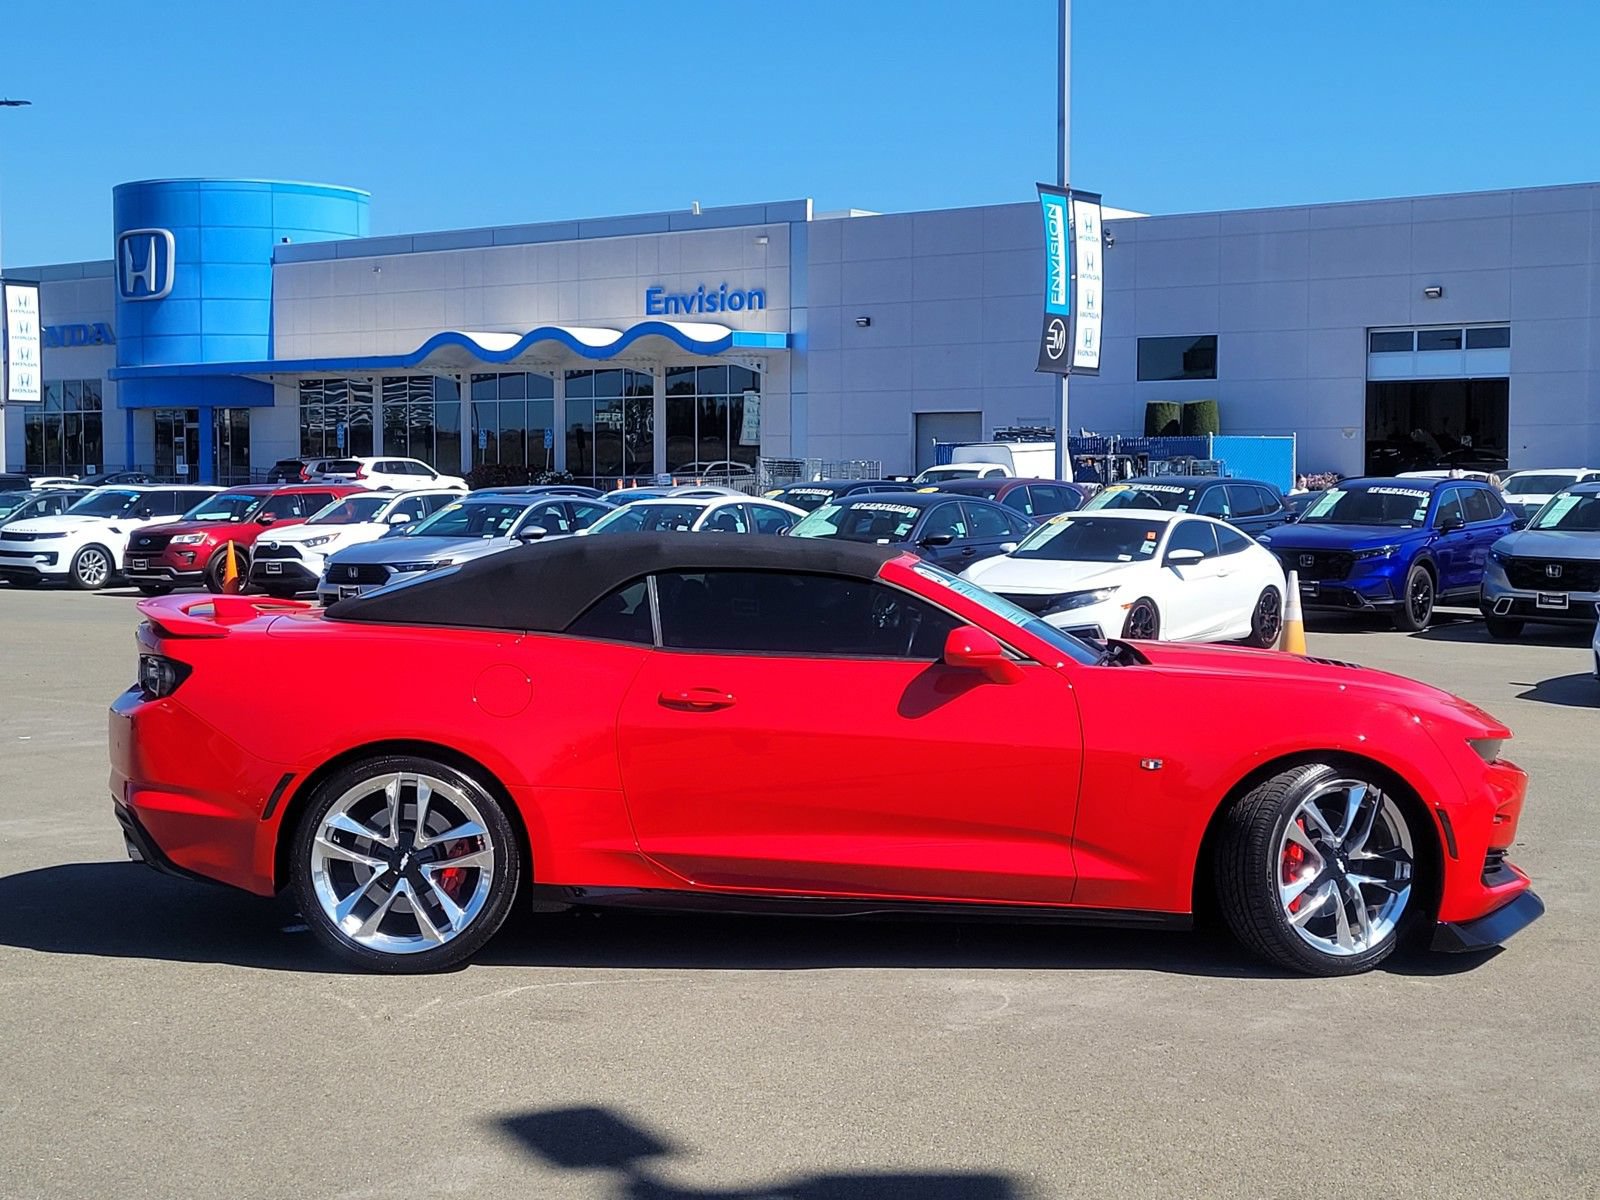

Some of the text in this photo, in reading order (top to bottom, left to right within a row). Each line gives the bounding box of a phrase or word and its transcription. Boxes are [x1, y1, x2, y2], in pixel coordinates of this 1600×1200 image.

[1046, 203, 1063, 306] ENVISION
[645, 283, 766, 316] Envision
[43, 322, 116, 348] NDA
